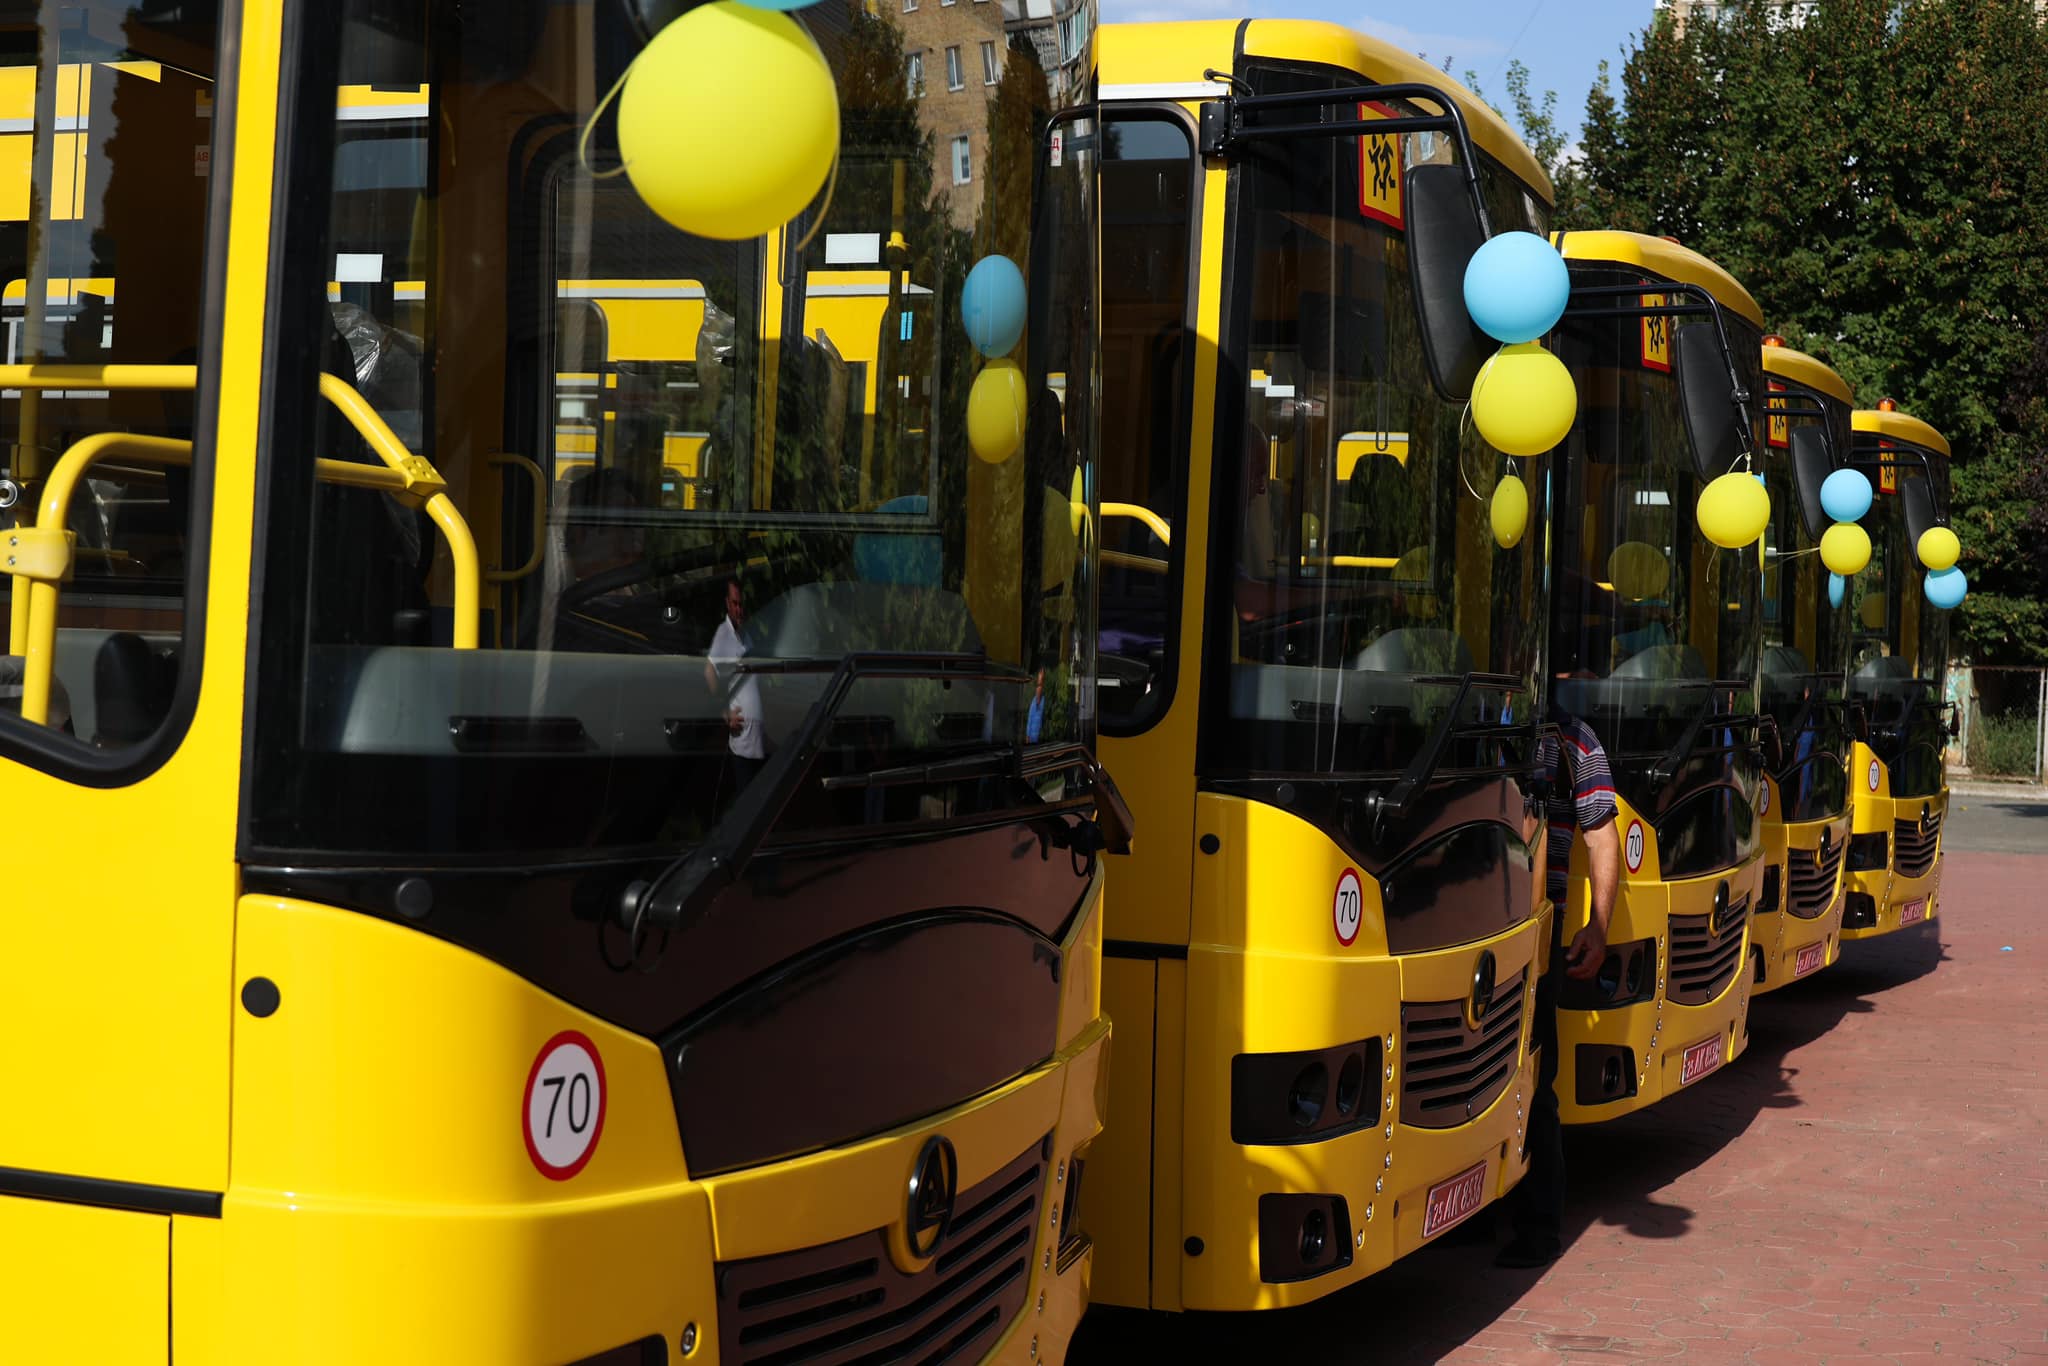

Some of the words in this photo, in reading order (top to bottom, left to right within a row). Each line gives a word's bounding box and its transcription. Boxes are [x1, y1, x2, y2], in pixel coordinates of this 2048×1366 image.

[1629, 834, 1641, 858] 70
[1340, 890, 1358, 924] 70
[542, 1072, 591, 1139] 70
